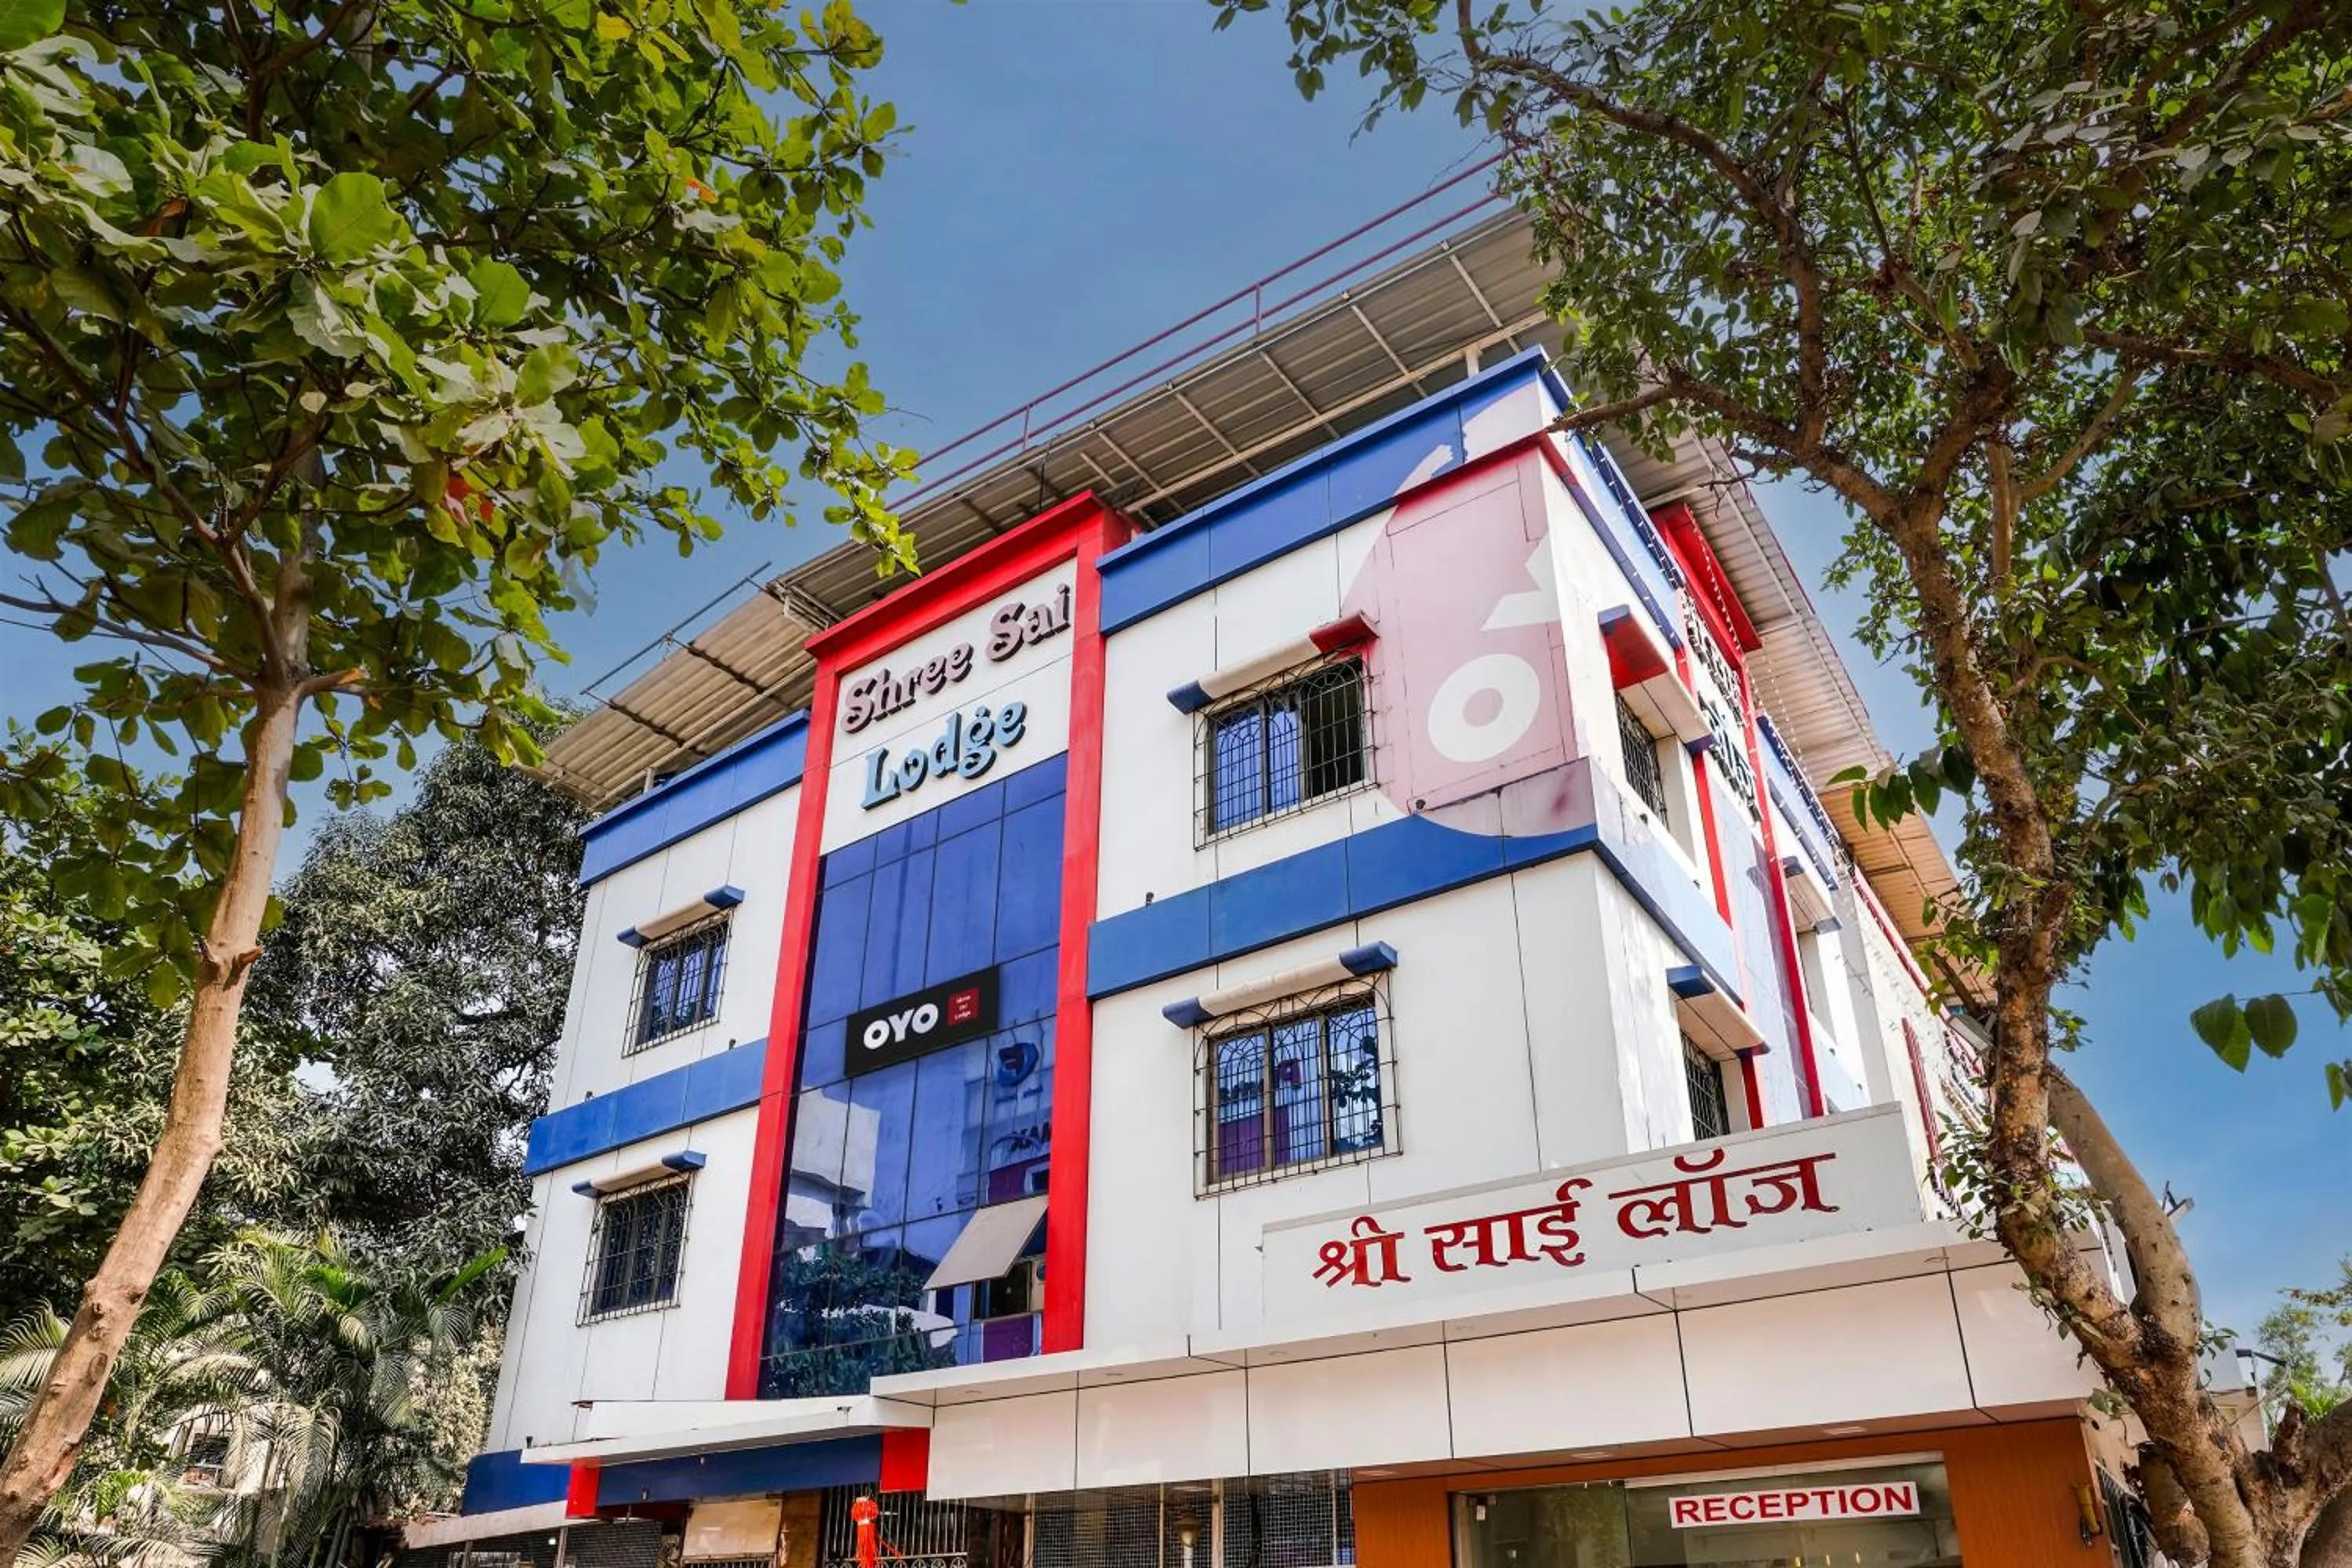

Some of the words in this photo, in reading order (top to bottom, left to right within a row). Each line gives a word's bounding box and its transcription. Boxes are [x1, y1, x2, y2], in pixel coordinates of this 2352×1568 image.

[842, 642, 973, 734] Shree
[988, 583, 1071, 662] Sai
[862, 700, 1027, 811] Lodge
[863, 1003, 938, 1050] OYO
[1312, 1215, 1411, 1288] श्री
[1424, 1178, 1594, 1272] साई
[1608, 1149, 1840, 1240] लॉज
[1674, 1485, 1914, 1524] RECEPTION
